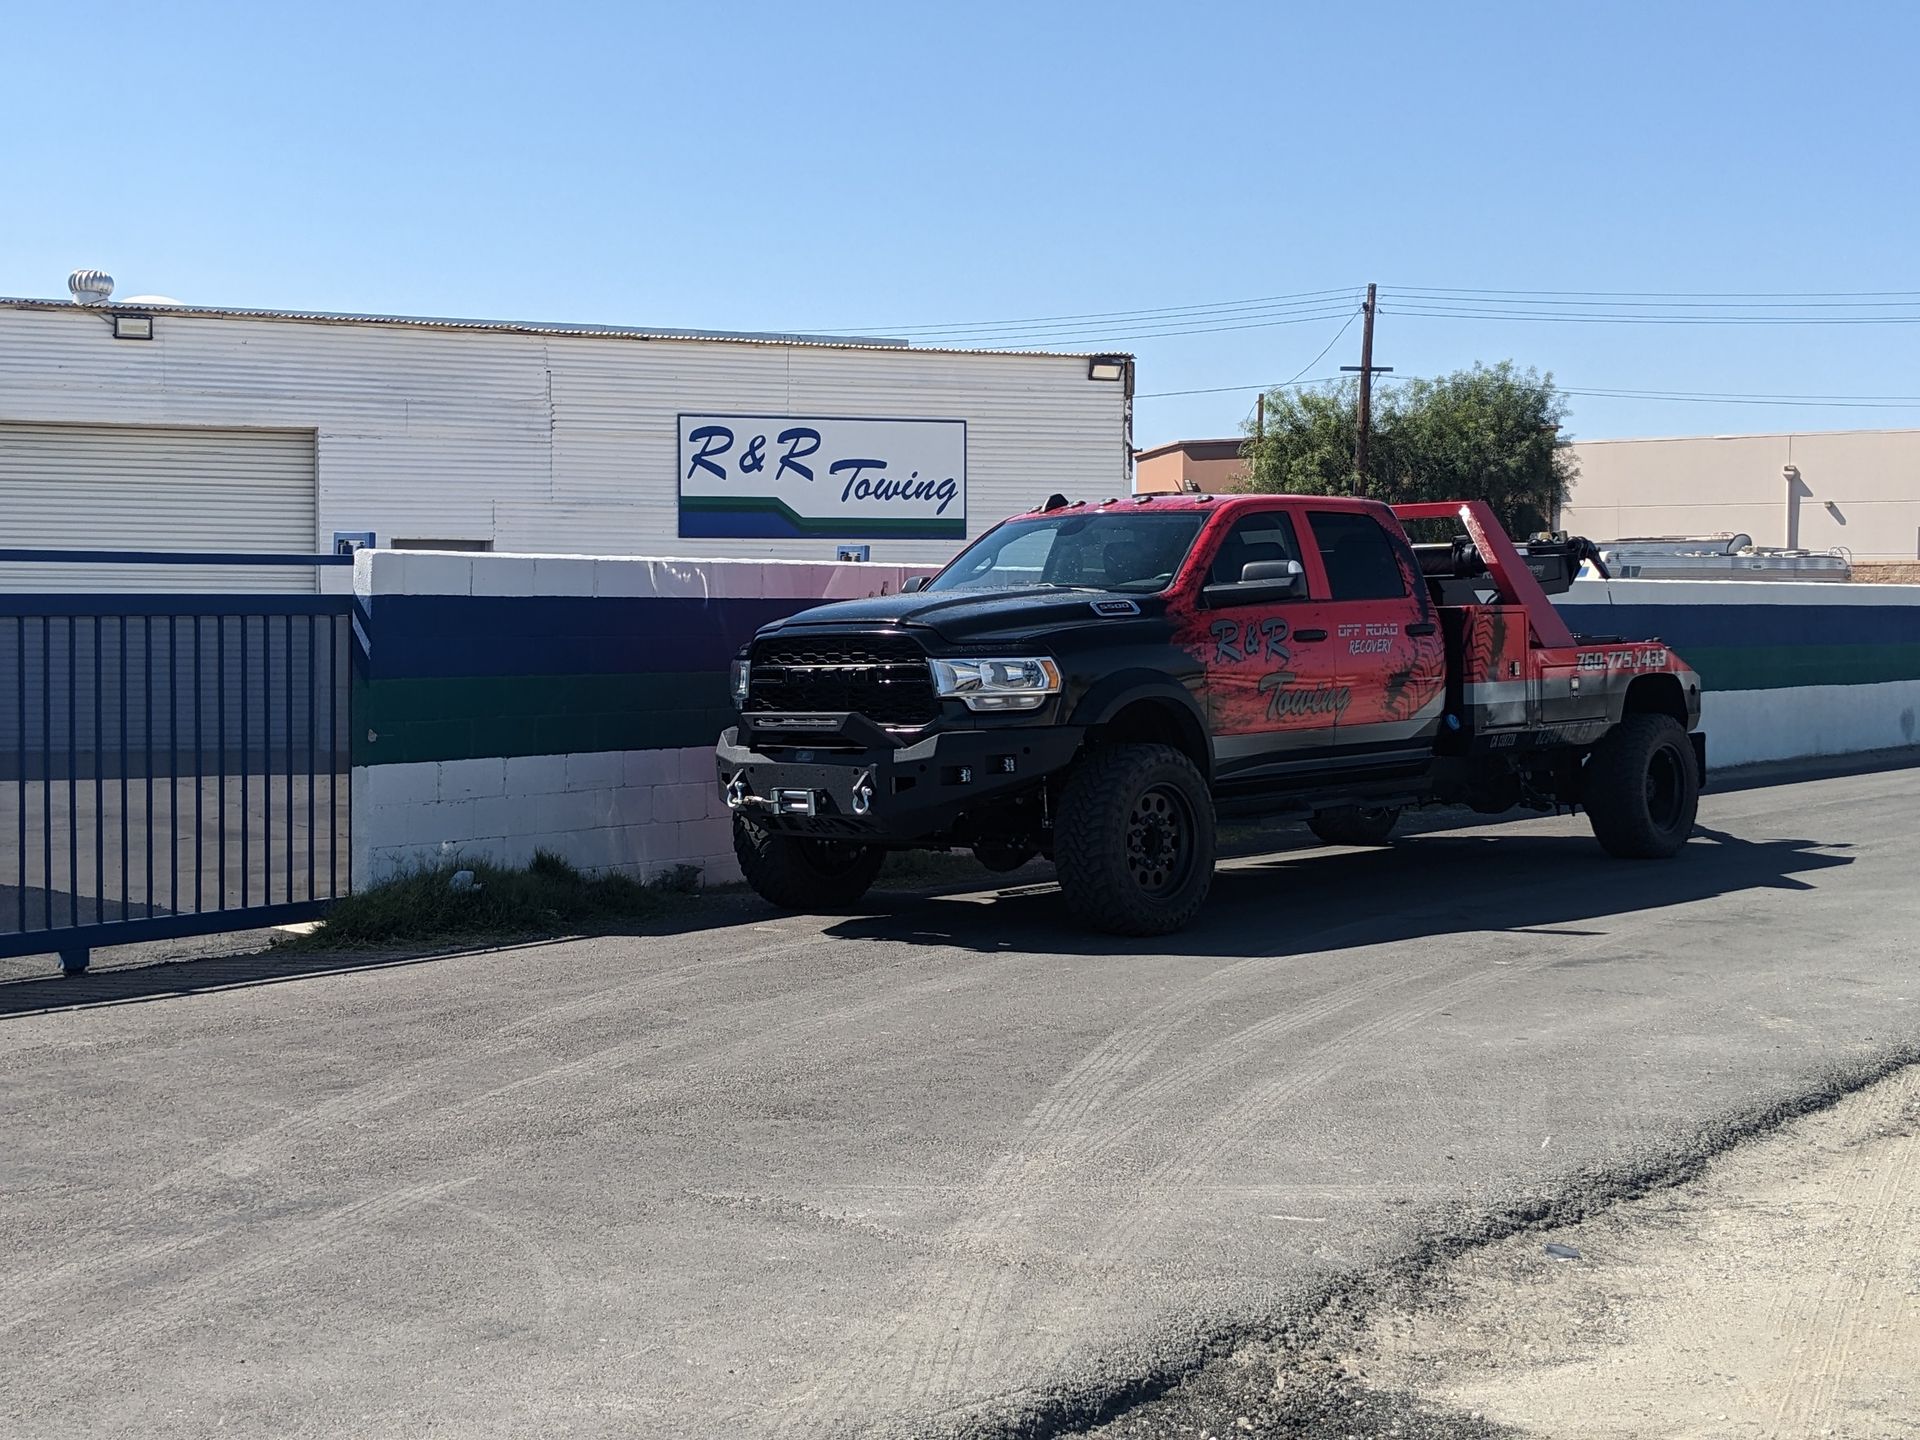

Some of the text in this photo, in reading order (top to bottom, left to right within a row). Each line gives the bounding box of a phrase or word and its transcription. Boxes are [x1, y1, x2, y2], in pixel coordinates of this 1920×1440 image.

[829, 458, 959, 516] Towing
[1337, 622, 1399, 637] OFF ROAD
[1348, 638, 1394, 656] RECOVERY
[1257, 671, 1352, 722] Towing
